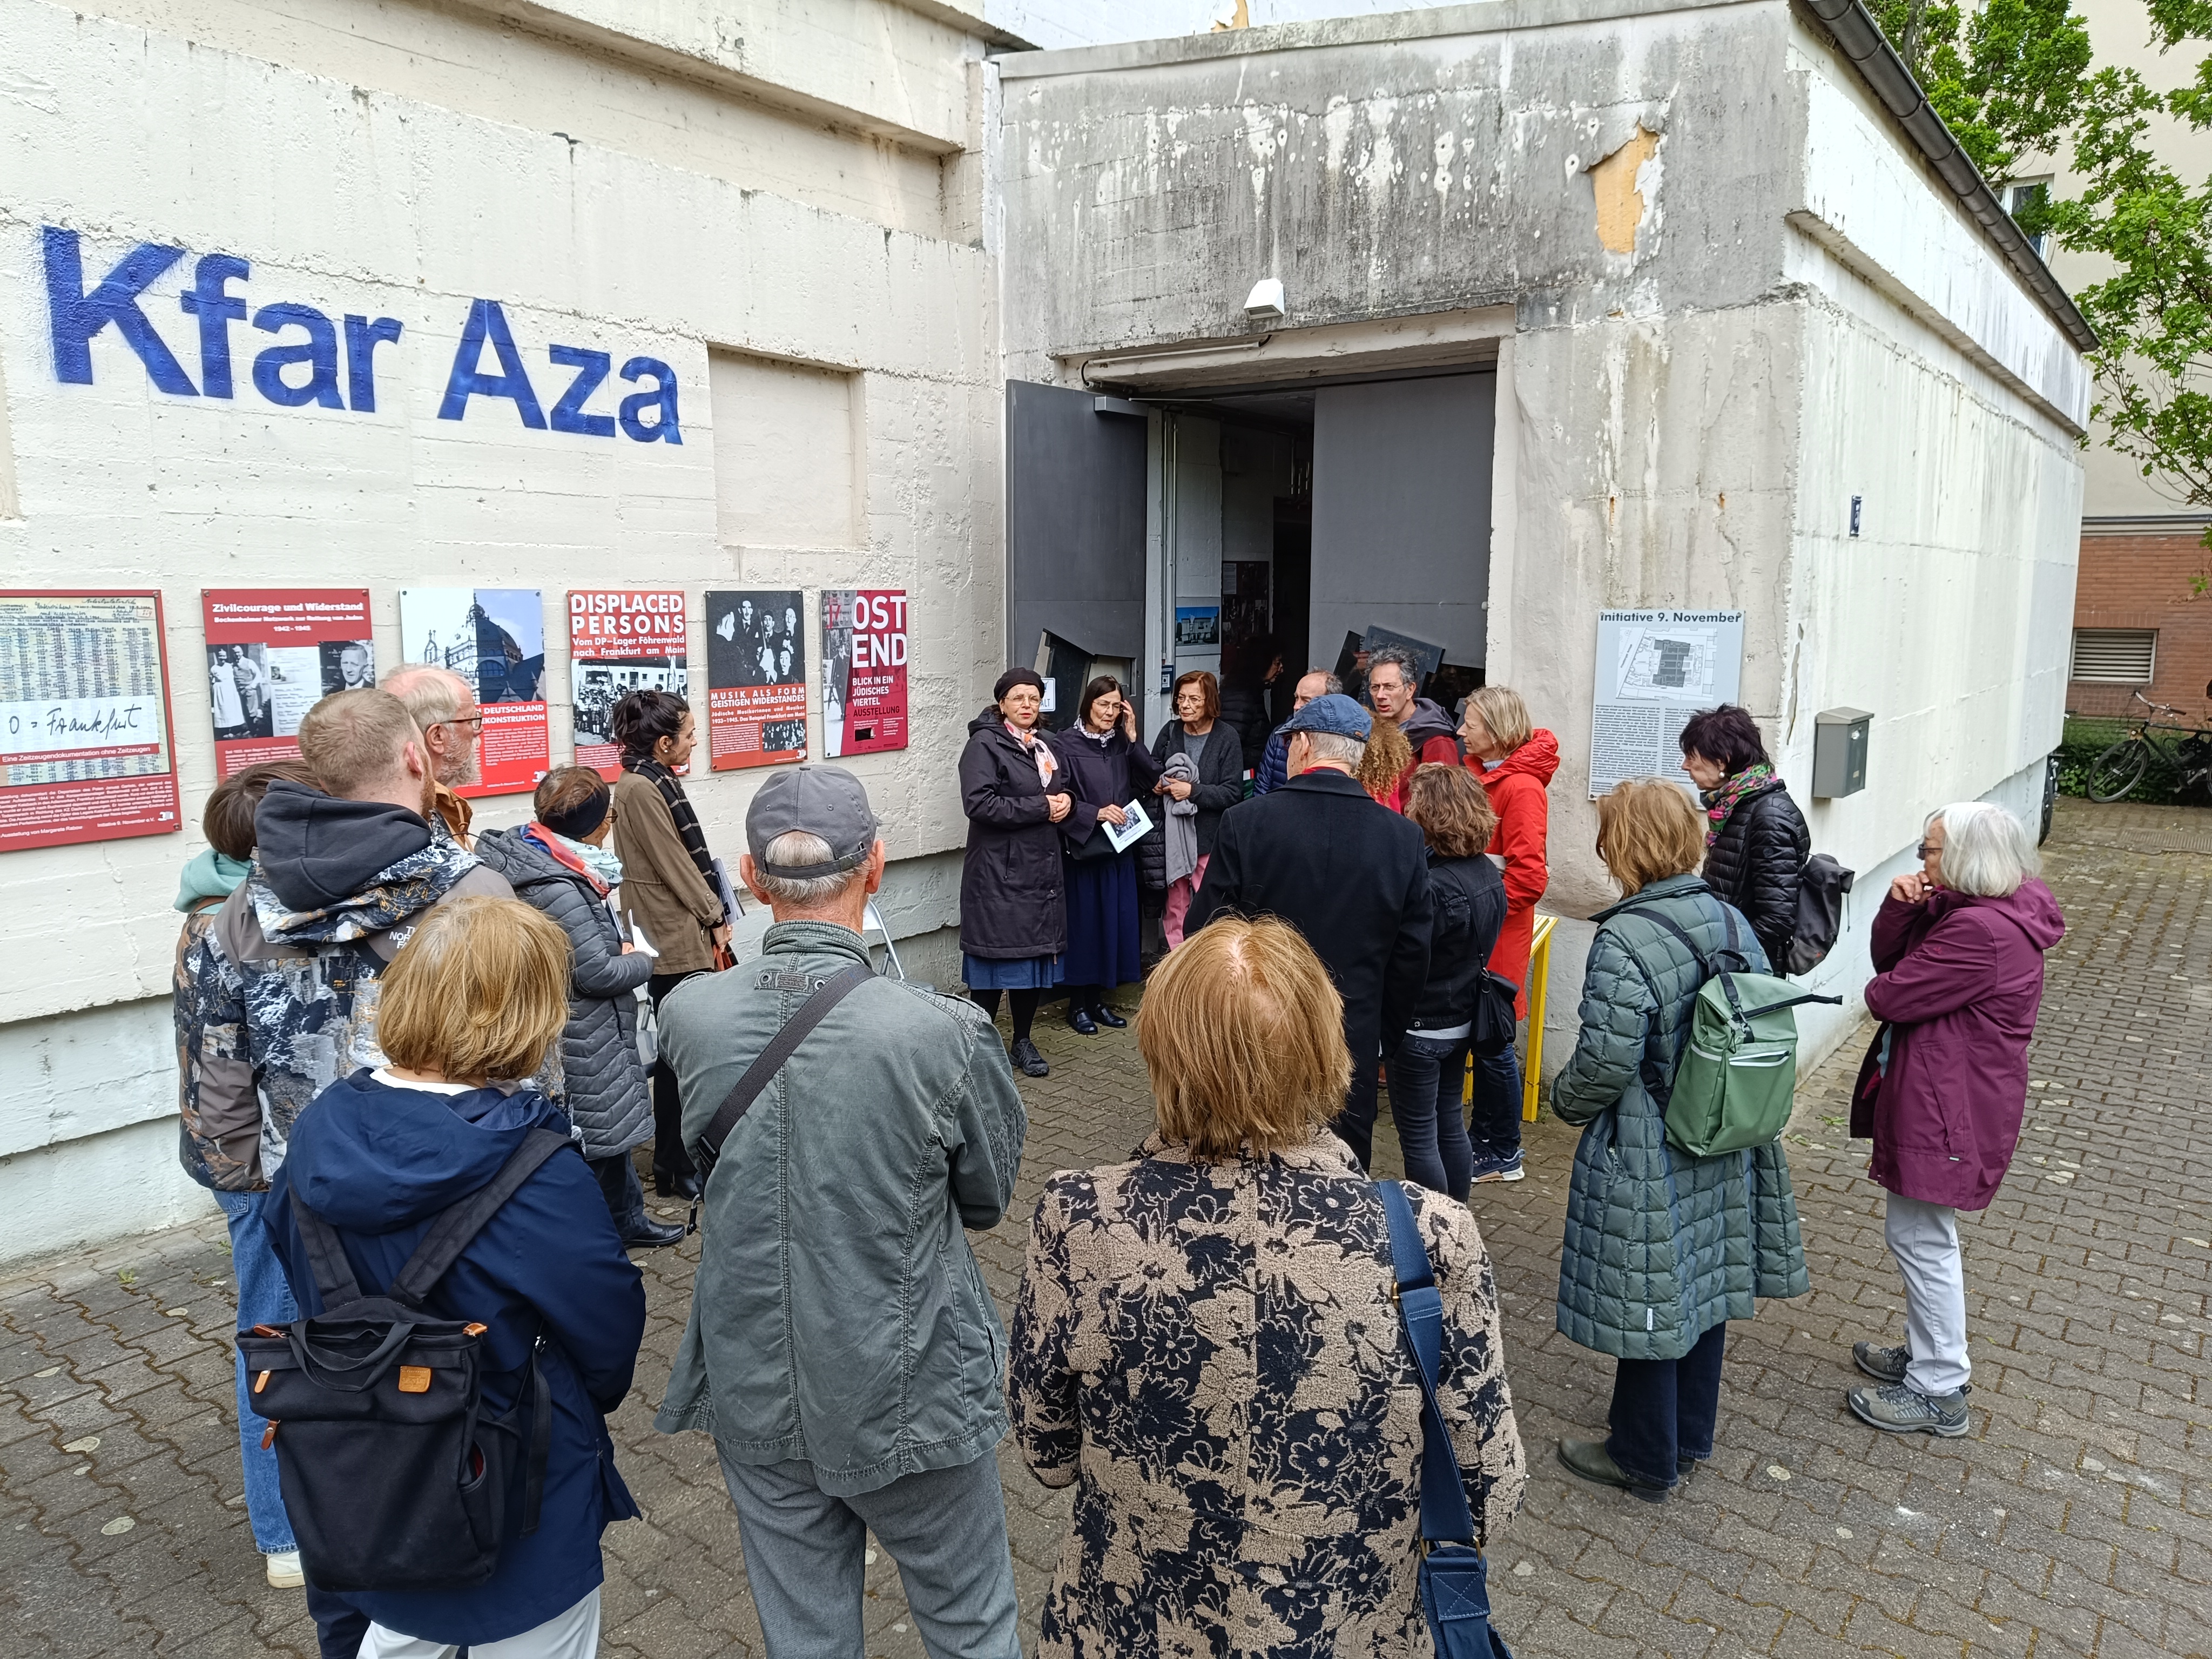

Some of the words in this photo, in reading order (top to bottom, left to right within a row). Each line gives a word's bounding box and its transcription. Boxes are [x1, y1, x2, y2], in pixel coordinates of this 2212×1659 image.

[42, 225, 403, 413] Kfar
[438, 298, 683, 446] Aza
[212, 604, 281, 613] Zivilcourage
[305, 602, 364, 611] Widerstand
[571, 594, 683, 613] DISPLACED
[852, 596, 906, 630] OST
[1600, 612, 1653, 622] Initiative
[1658, 612, 1668, 622] 9.
[1673, 612, 1739, 622] November
[572, 615, 684, 635] PERSONS
[572, 637, 592, 646] Vom
[639, 635, 685, 644] Föhrenwald
[574, 649, 595, 657] nach
[601, 648, 640, 656] Frankfurt
[665, 646, 685, 654] Main
[852, 633, 907, 668] END
[853, 677, 872, 686] BLICK
[874, 676, 881, 684] IN
[882, 676, 893, 684] EIN
[711, 691, 746, 700] MUSIK
[753, 689, 771, 697] ALS
[778, 686, 805, 696] FORM
[853, 686, 889, 696] JÜDISCHES
[711, 698, 750, 708] GEISTIGEN
[752, 694, 805, 705] WIDERSTANDES
[853, 697, 880, 706] VIERTEL
[484, 705, 544, 714] DEUTSCHLAND
[853, 706, 900, 717] AUSSTELLUNG
[46, 704, 142, 740] Frankfurt
[481, 714, 545, 724] EKONSTRUKTION
[19, 750, 99, 760] Zeitzeugendokumentation
